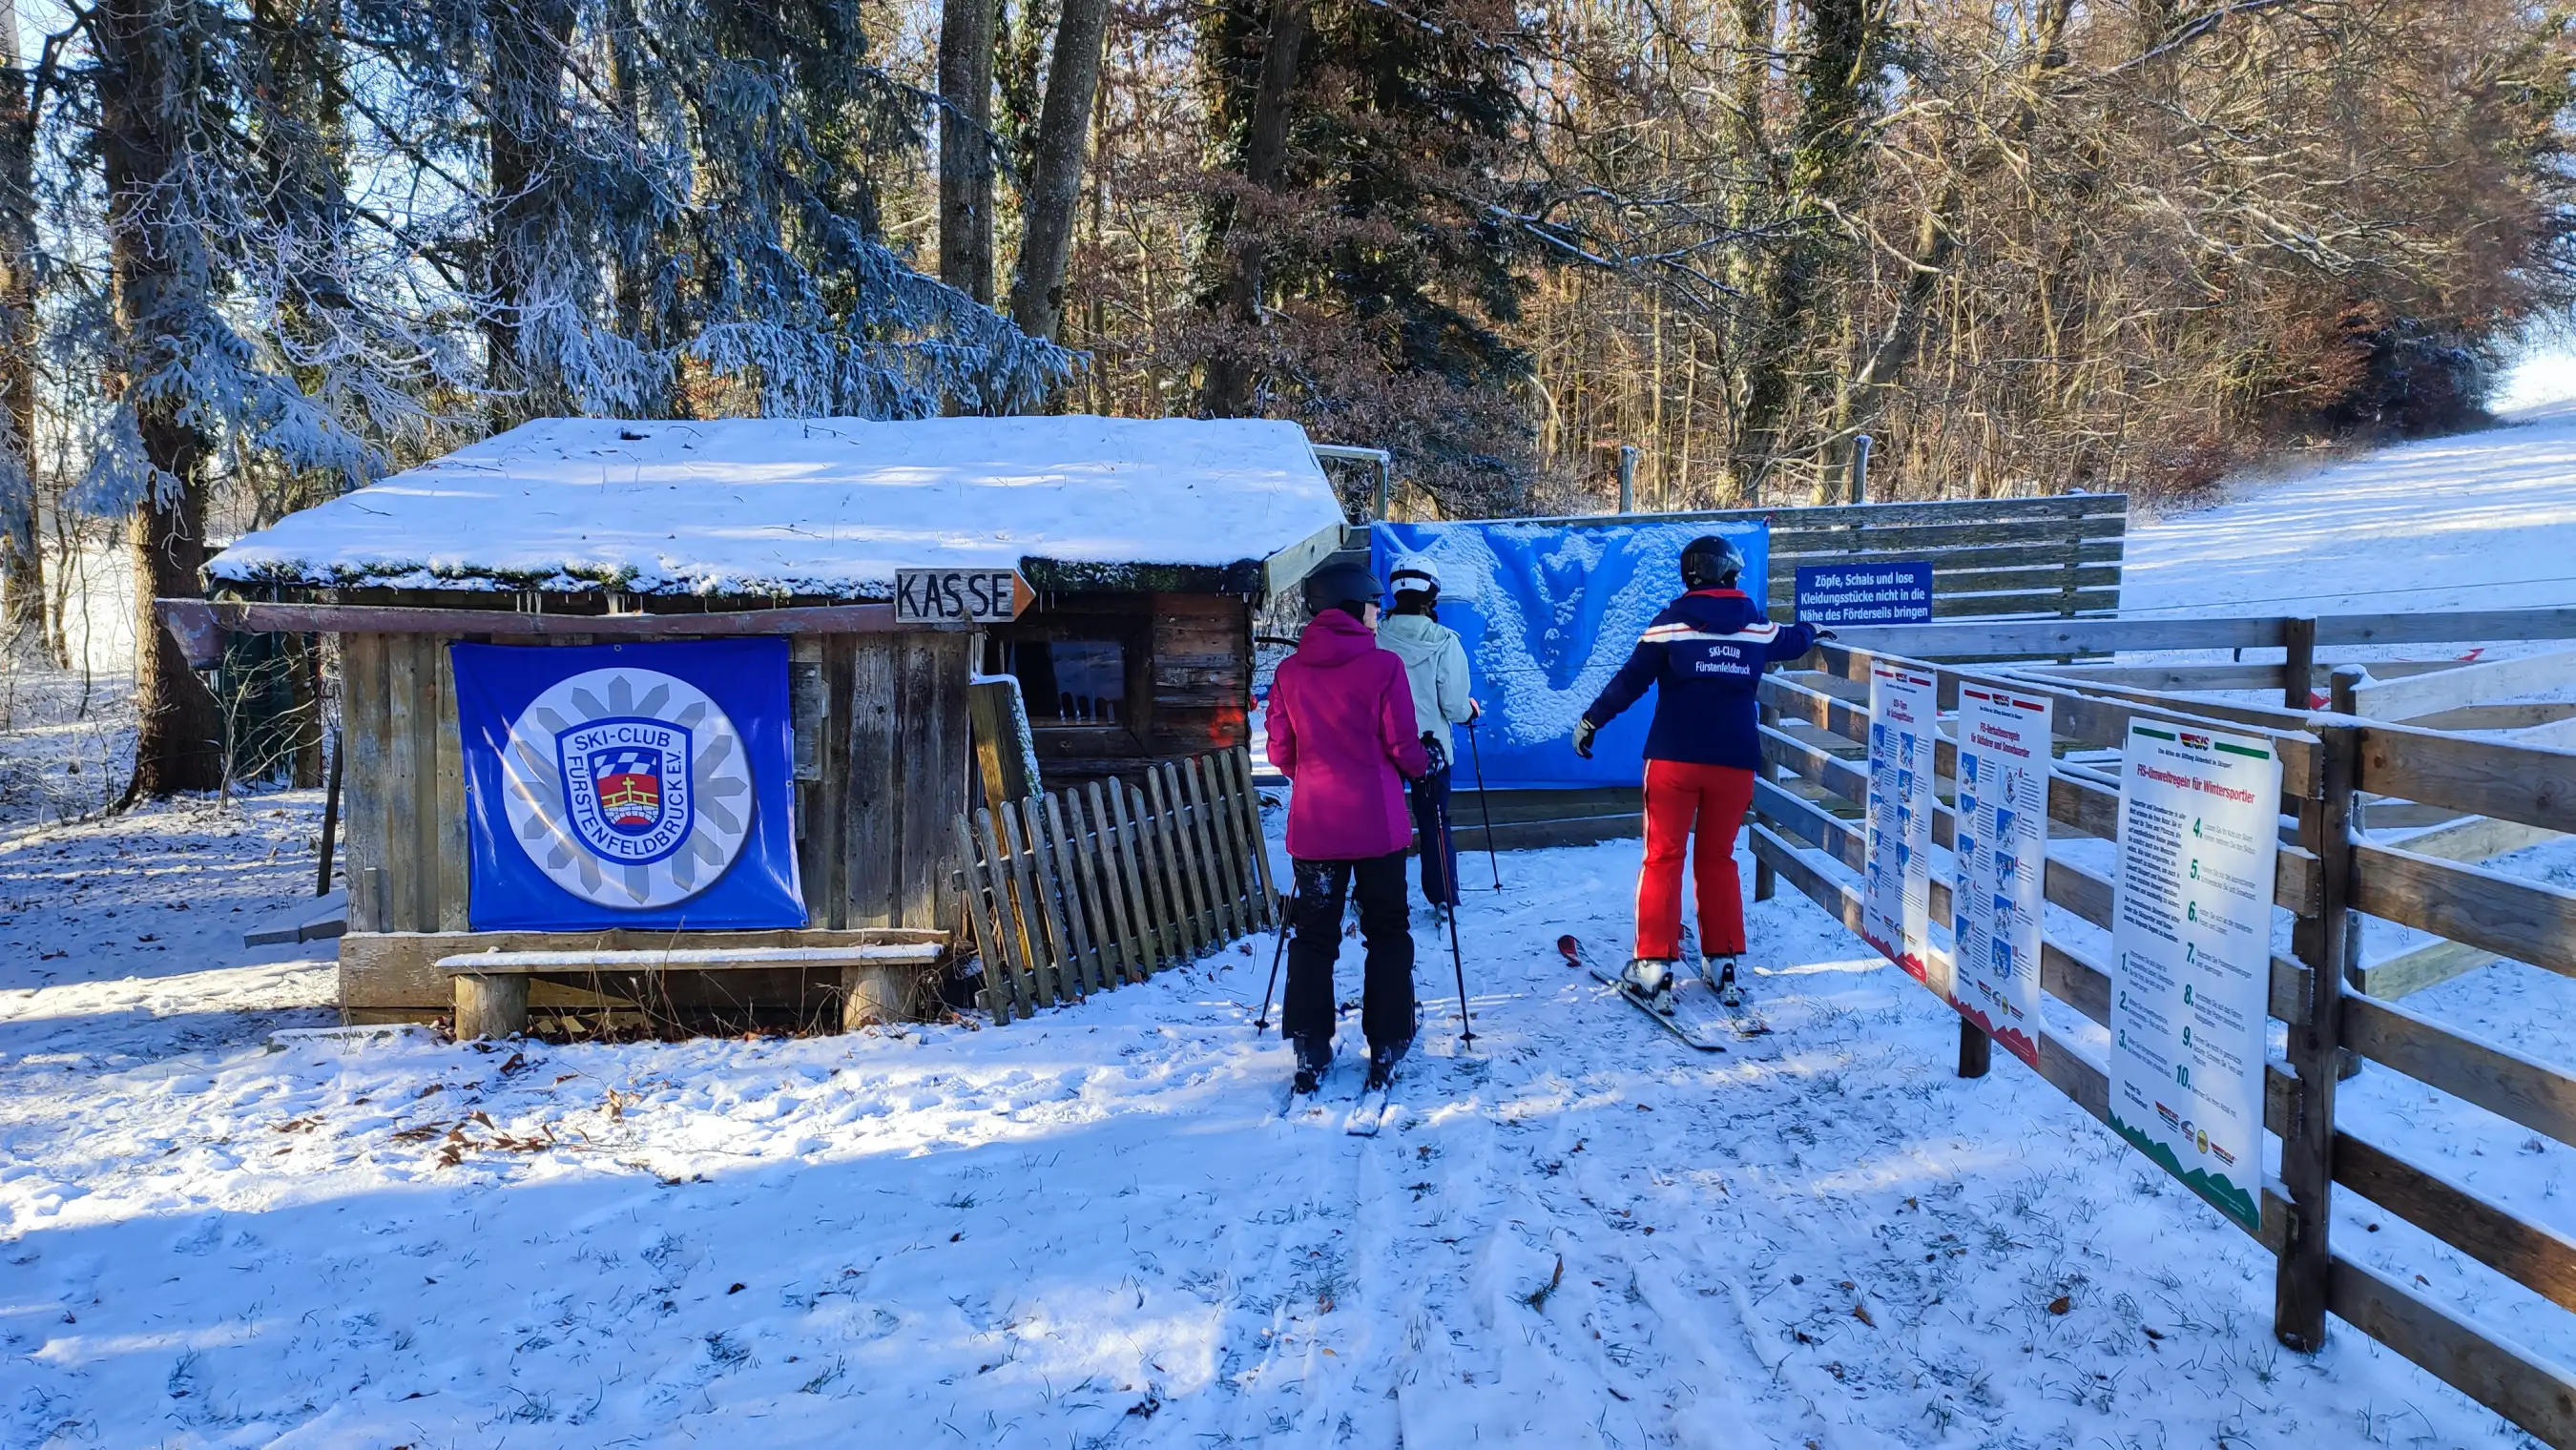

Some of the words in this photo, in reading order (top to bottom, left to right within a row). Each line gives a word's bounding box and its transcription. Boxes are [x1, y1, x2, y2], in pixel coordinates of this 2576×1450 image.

[1815, 574, 1843, 590] Zöpfe,
[1845, 572, 1874, 587] Schals
[1877, 571, 1893, 585] und
[1896, 571, 1914, 584] lose
[897, 573, 1013, 617] KASSE
[1800, 590, 1874, 606] Kleidungsstücke
[1876, 589, 1899, 602] nicht
[1901, 588, 1908, 601] in
[1911, 588, 1925, 600] die
[1799, 610, 1823, 622] Nähe
[1825, 608, 1841, 621] des
[1843, 606, 1892, 620] Förderseils
[1894, 605, 1928, 620] bringen
[1709, 646, 1741, 659] SKI-CLUB
[1695, 660, 1751, 675] Fürstenfeldbruck
[573, 727, 671, 751] SKI-CLUB
[2136, 763, 2191, 790] FIS-Umweltregeln
[2192, 777, 2202, 791] für
[2203, 779, 2255, 804] Wintersportler
[568, 756, 685, 856] FÜRSTENFELDBRUCK
[2192, 818, 2203, 839] 4.
[2190, 859, 2200, 880] 5.
[2188, 901, 2198, 923] 6.
[2121, 952, 2128, 973] 1.
[2186, 942, 2195, 964] 7.
[2119, 990, 2129, 1012] 2.
[2183, 984, 2194, 1007] 8.
[2118, 1028, 2128, 1050] 3.
[2182, 1025, 2192, 1048] 9.
[2176, 1064, 2192, 1089] 10.
